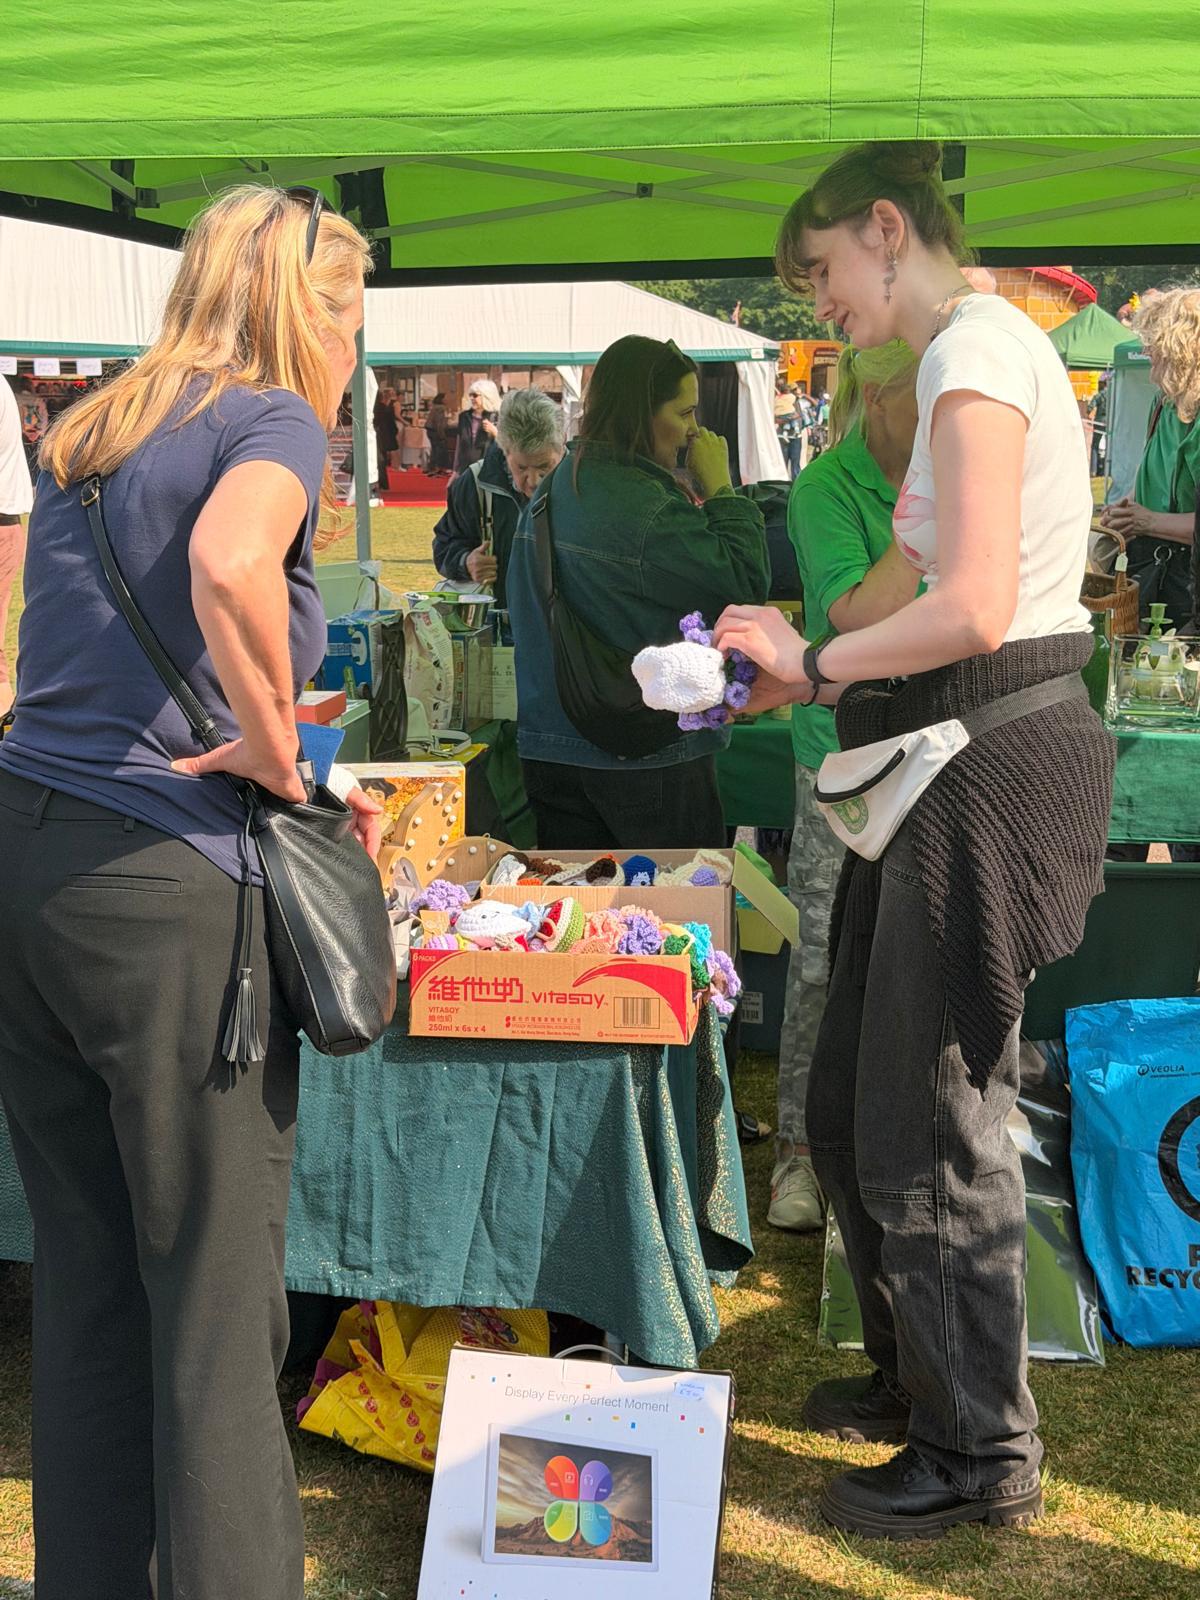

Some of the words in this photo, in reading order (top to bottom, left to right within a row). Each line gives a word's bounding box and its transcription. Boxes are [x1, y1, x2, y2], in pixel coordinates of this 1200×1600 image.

[428, 975, 523, 1003] 維他奶
[532, 991, 605, 1009] vitasoy
[428, 1024, 453, 1032] 250ml
[1150, 1064, 1185, 1073] VEOLIA
[504, 1386, 545, 1401] Display
[547, 1390, 578, 1405] Every
[582, 1393, 621, 1408] Perfect
[624, 1398, 669, 1413] Moment
